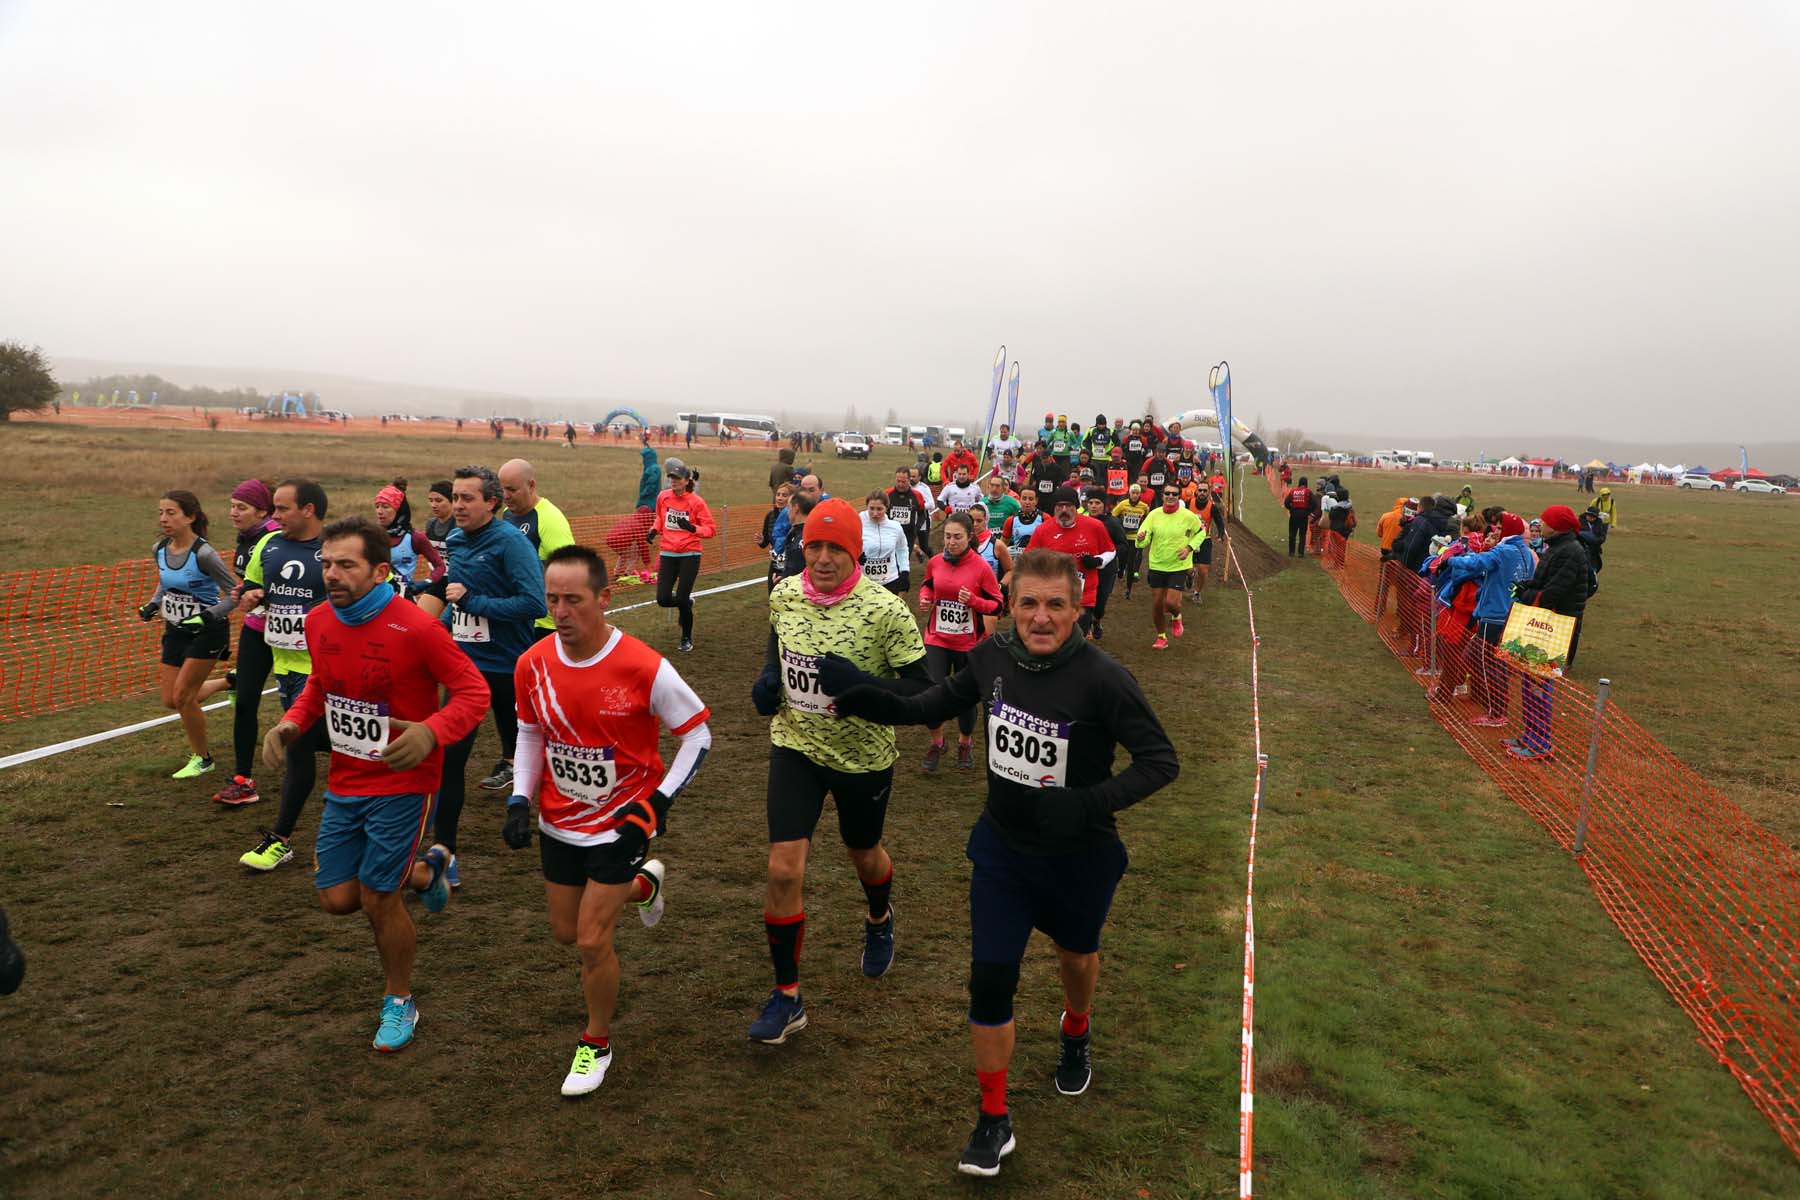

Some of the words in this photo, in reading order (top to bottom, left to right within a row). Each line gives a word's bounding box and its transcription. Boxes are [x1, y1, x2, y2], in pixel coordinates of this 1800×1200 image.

[865, 564, 888, 575] 6633
[269, 582, 313, 598] Adarsa
[165, 600, 195, 617] 6117
[940, 609, 970, 624] 6632
[268, 615, 305, 635] 6304
[326, 693, 379, 711] DIPUTACIÓN
[327, 700, 379, 716] BURGOS
[1000, 710, 1059, 738] BURGOS
[1001, 704, 1059, 730] DIPUTACIÓN
[330, 710, 382, 742] 6530
[549, 740, 604, 755] DIPUTACIÓN
[550, 747, 605, 761] BURGOS
[995, 725, 1058, 768] 6303
[552, 757, 608, 788] 6533
